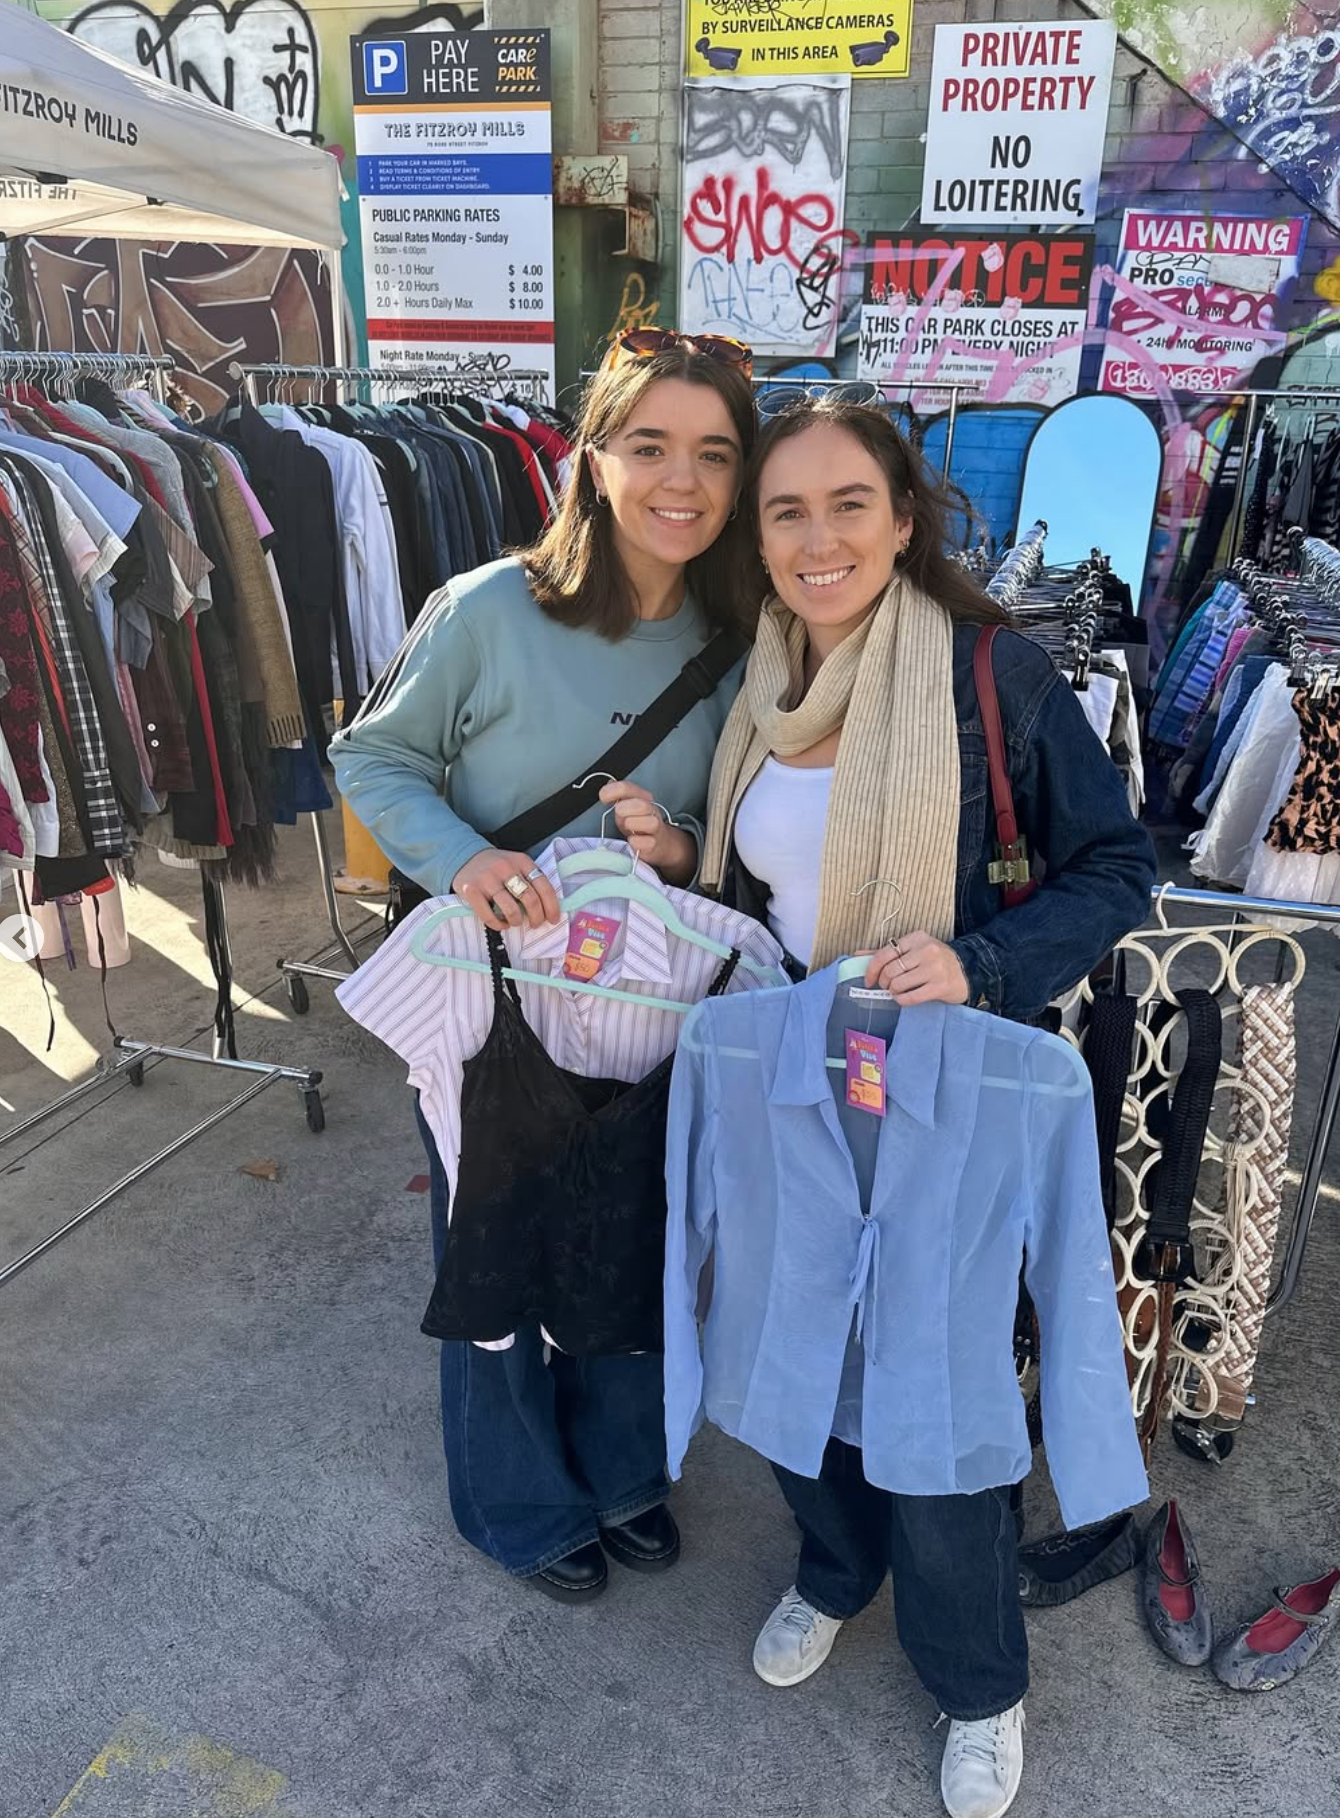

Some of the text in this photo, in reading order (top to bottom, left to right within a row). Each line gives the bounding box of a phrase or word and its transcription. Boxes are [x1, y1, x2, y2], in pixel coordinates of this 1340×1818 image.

[702, 14, 894, 35] BY SURVEILLANCE CAMERAS
[430, 39, 470, 65] PAY
[752, 46, 838, 61] IN THIS AREA
[961, 30, 1082, 67] PRIVATE
[372, 48, 398, 88] P
[497, 66, 537, 81] PARK
[423, 68, 480, 94] HERE
[942, 76, 1096, 112] PROPERTY
[85, 108, 138, 146] MILLS
[384, 121, 526, 138] THE FITZROY MILLS
[990, 134, 1031, 169] NO
[933, 179, 1082, 212] LOITERING
[372, 208, 500, 222] PUBLIC PARKING RATES
[373, 232, 403, 243] Casual
[405, 232, 430, 243] Rates
[432, 233, 466, 245] Monday
[475, 233, 508, 245] Sunday
[1136, 220, 1290, 252] WARNING
[375, 264, 389, 274] 0.0
[398, 264, 412, 274] 1.0
[414, 264, 434, 275] Hour
[508, 265, 515, 276] $
[522, 265, 543, 276] 4.00
[872, 239, 1084, 304] NOTICE
[1129, 267, 1175, 286] PRO
[376, 281, 390, 292] 1.0
[398, 281, 412, 292] 2.0
[414, 281, 439, 292] Hours
[508, 282, 515, 293] $
[522, 282, 543, 293] 8.00
[377, 298, 391, 308] 2.0
[405, 298, 430, 308] Hours
[431, 298, 453, 311] Daily
[455, 298, 473, 309] Max
[509, 298, 515, 310] $
[518, 299, 544, 310] 10.00
[866, 316, 1079, 338] THIS CAR PARK CLOSES AT
[380, 350, 403, 362] Night
[404, 350, 424, 360] Rate
[426, 350, 460, 363] Monday
[881, 337, 918, 355] 11:00
[951, 339, 1003, 357] EVERY
[1008, 340, 1057, 359] NIGHT
